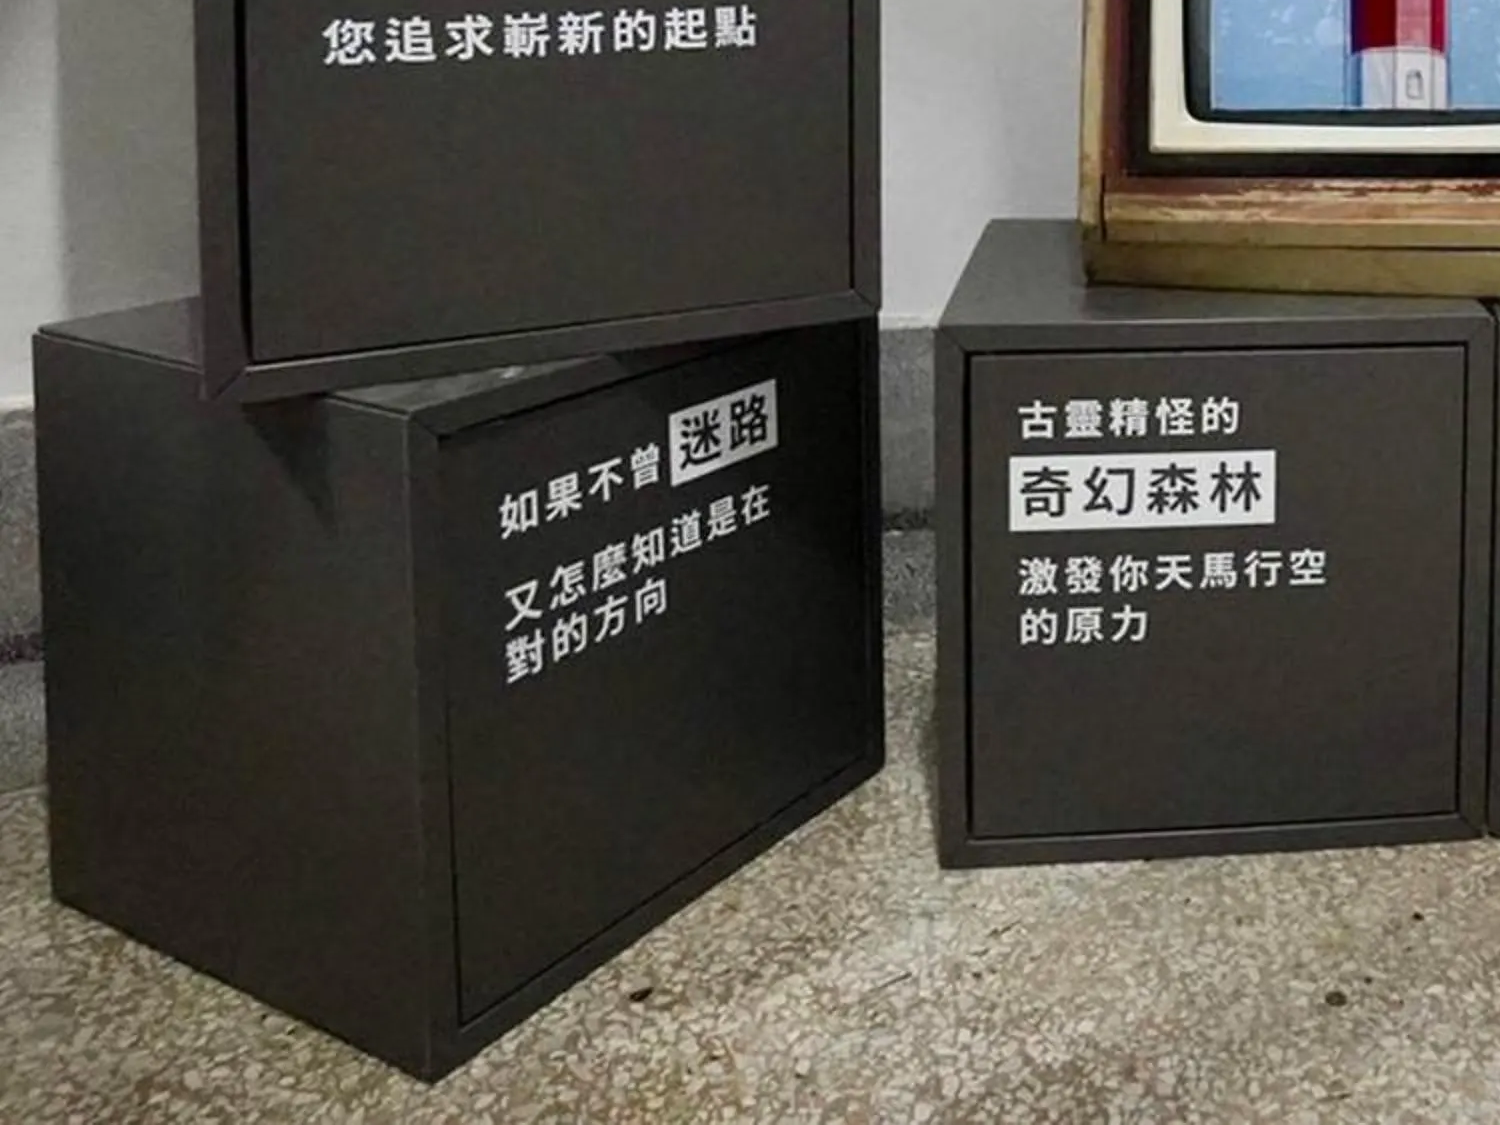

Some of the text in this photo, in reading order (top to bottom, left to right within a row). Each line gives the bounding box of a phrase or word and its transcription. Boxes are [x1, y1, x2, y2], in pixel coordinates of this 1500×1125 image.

[322, 4, 757, 65] 您追求嶄新的起點
[1018, 396, 1239, 440] 古靈精怪的
[1019, 460, 1262, 518] 奇幻森林
[504, 485, 770, 631] 又怎麼知道是在
[1019, 548, 1326, 596] 激發你天馬行空
[505, 577, 667, 684] 對的方向
[1020, 604, 1147, 645] 的原力
